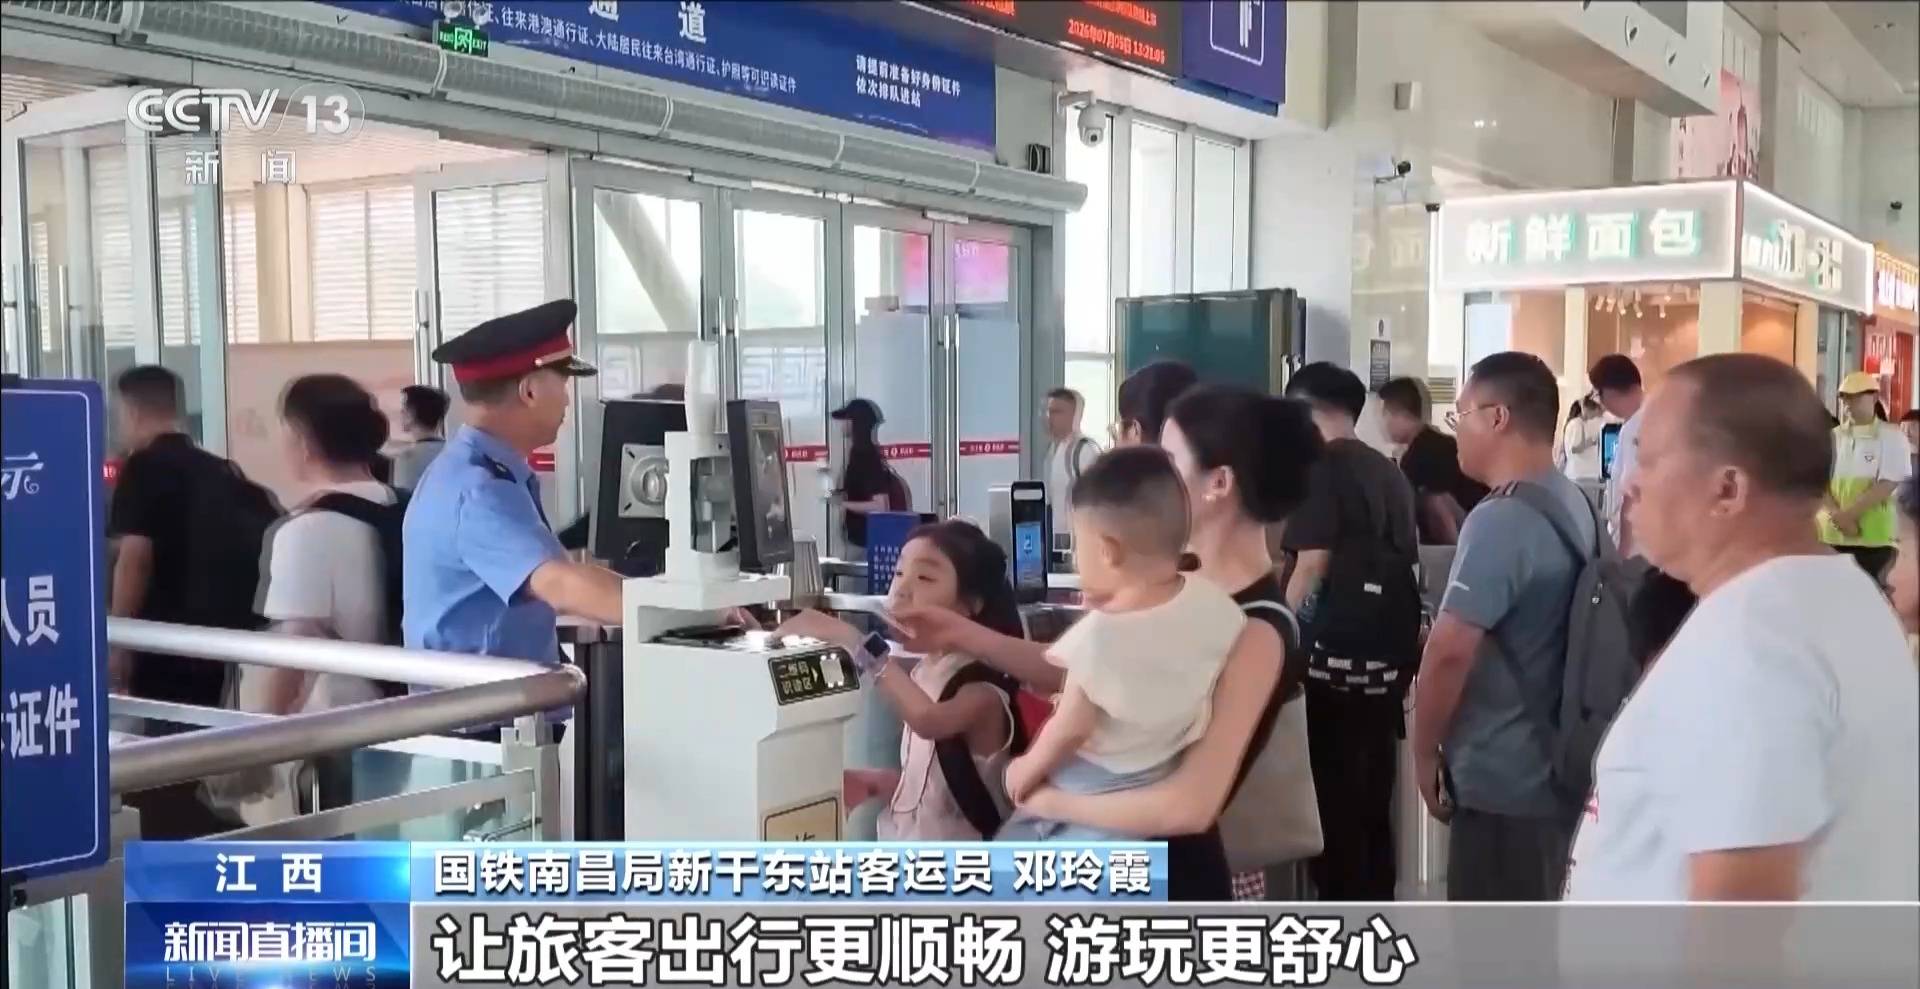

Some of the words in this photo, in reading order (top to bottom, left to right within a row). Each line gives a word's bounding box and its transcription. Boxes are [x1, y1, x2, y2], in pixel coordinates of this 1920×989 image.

[856, 54, 960, 97] 请提前准备好身份证件
[856, 75, 920, 107] 依次排队进站
[1465, 208, 1703, 265] 新鲜面包
